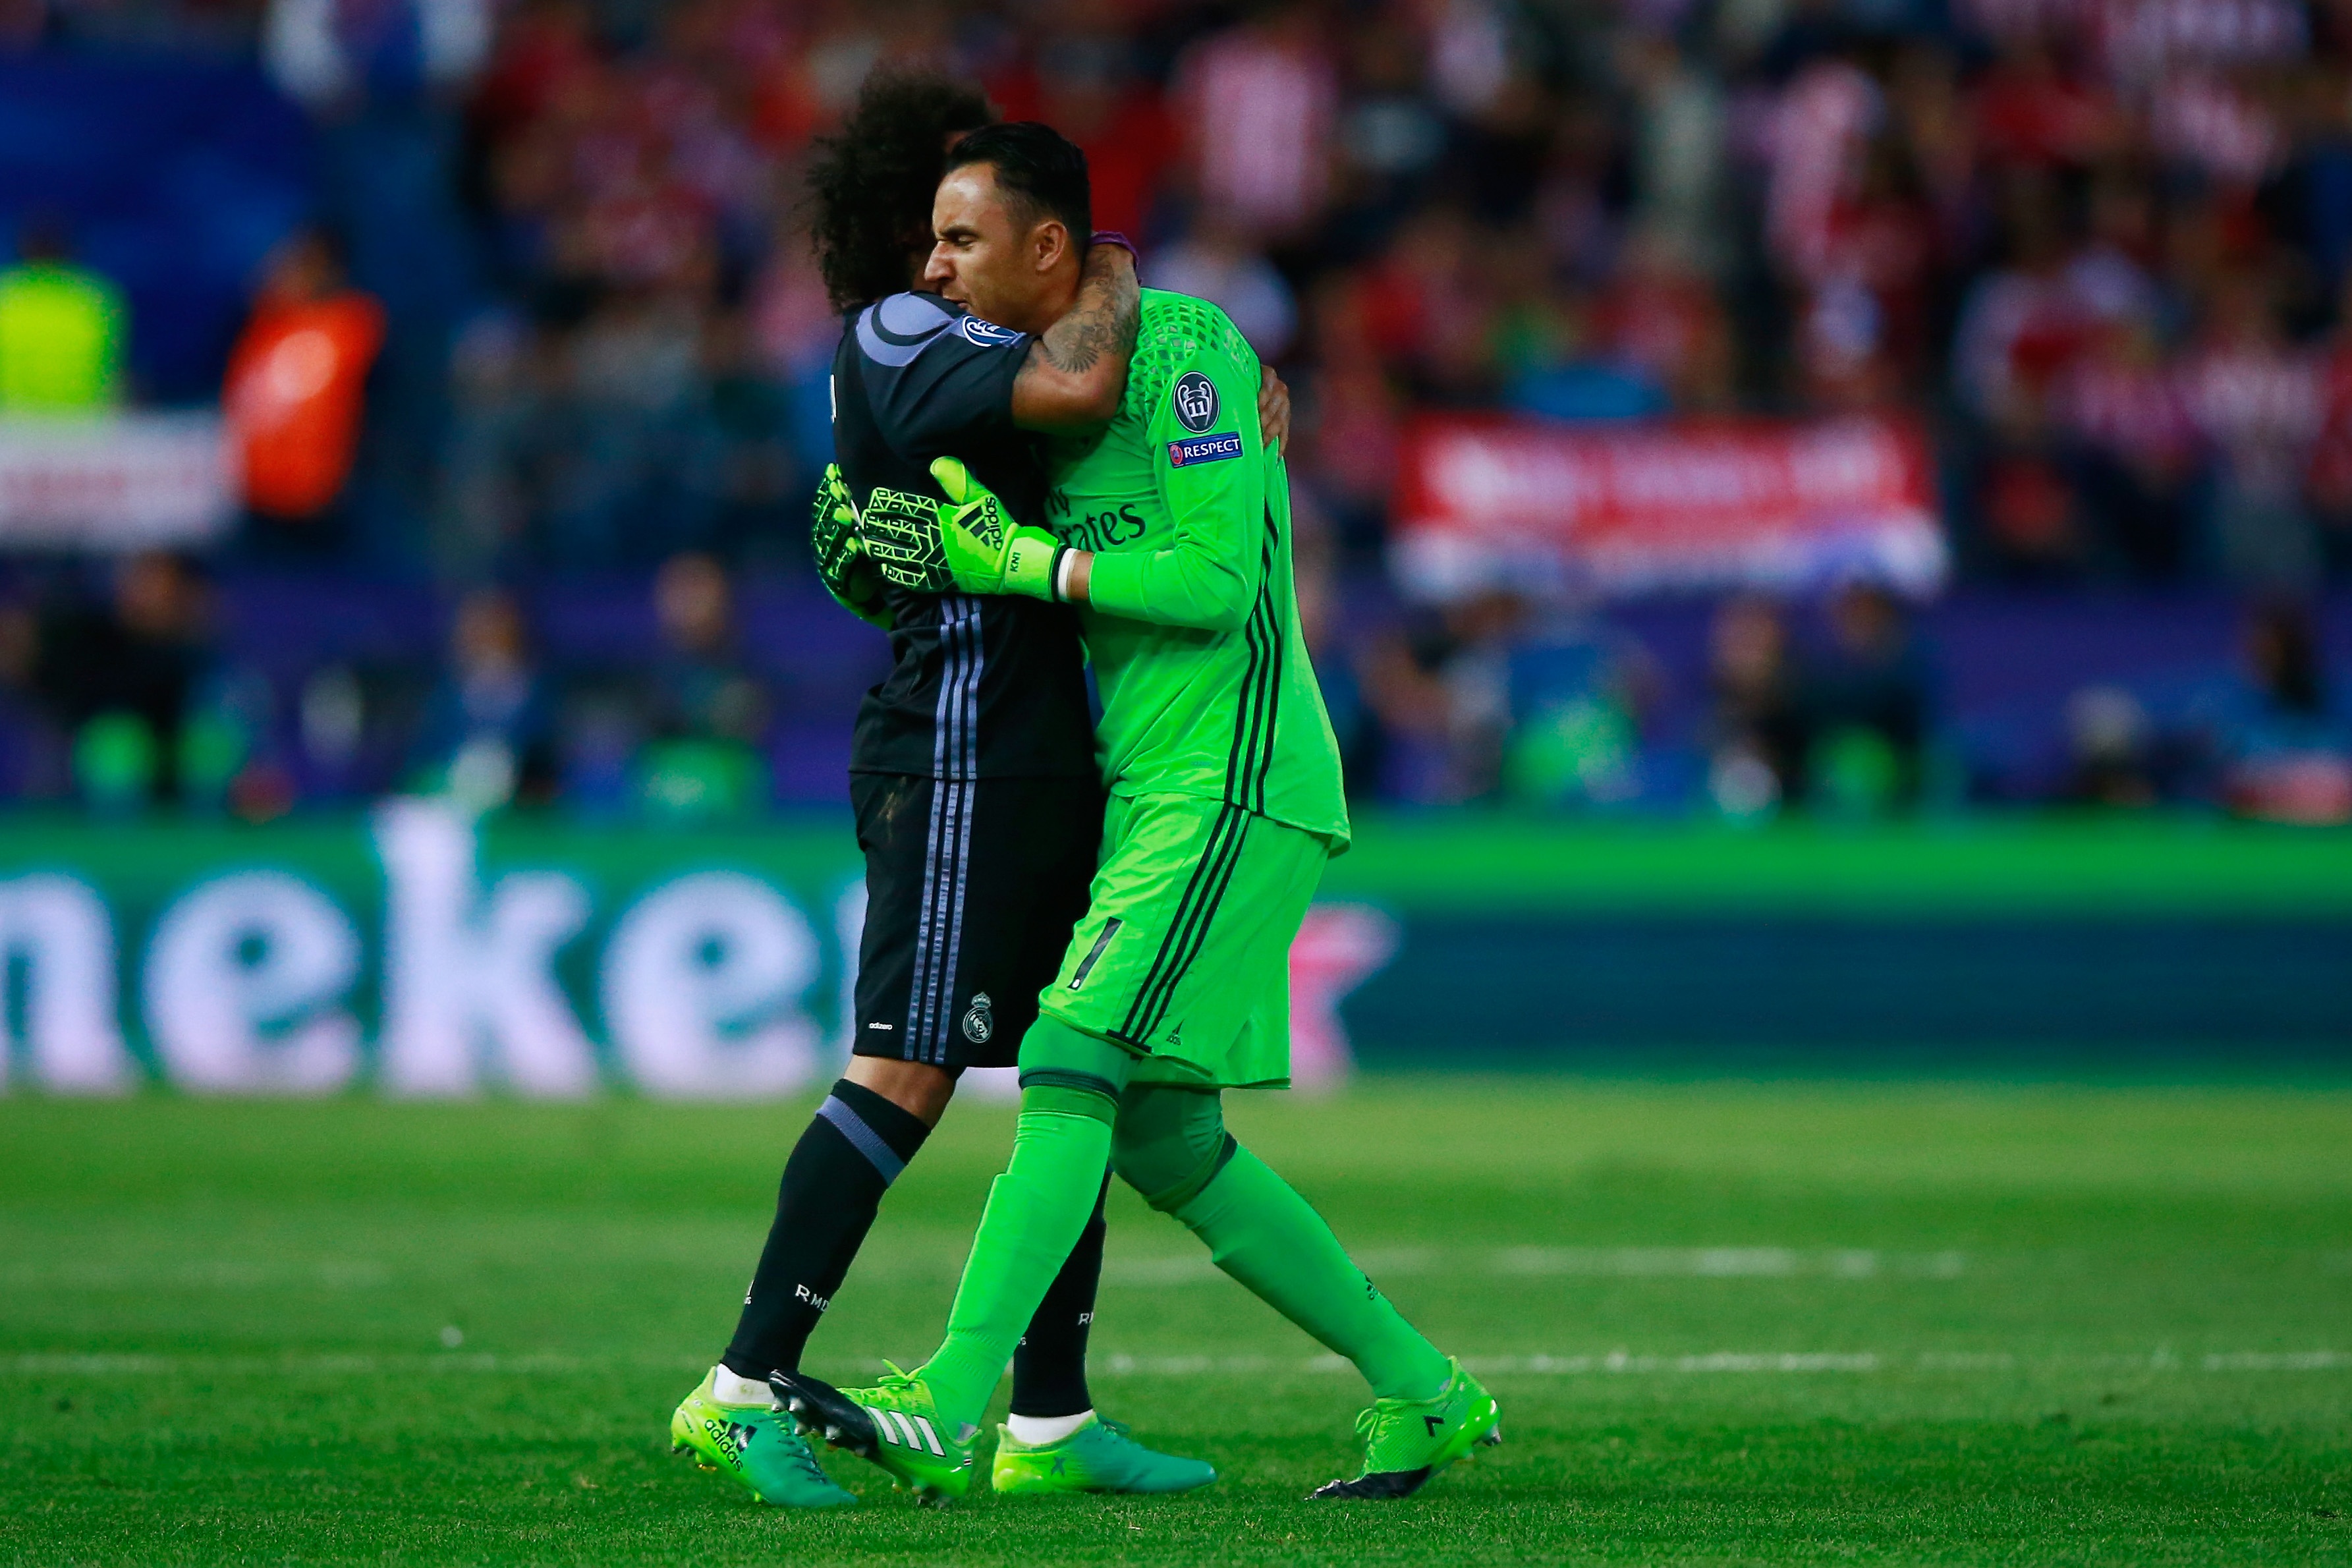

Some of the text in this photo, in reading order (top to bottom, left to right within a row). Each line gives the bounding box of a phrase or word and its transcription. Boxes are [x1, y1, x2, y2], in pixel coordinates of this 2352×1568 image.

[1189, 401, 1208, 418] 11
[1184, 439, 1240, 458] RESPECT
[986, 497, 1003, 551] adidas
[704, 1419, 743, 1472] adidas
